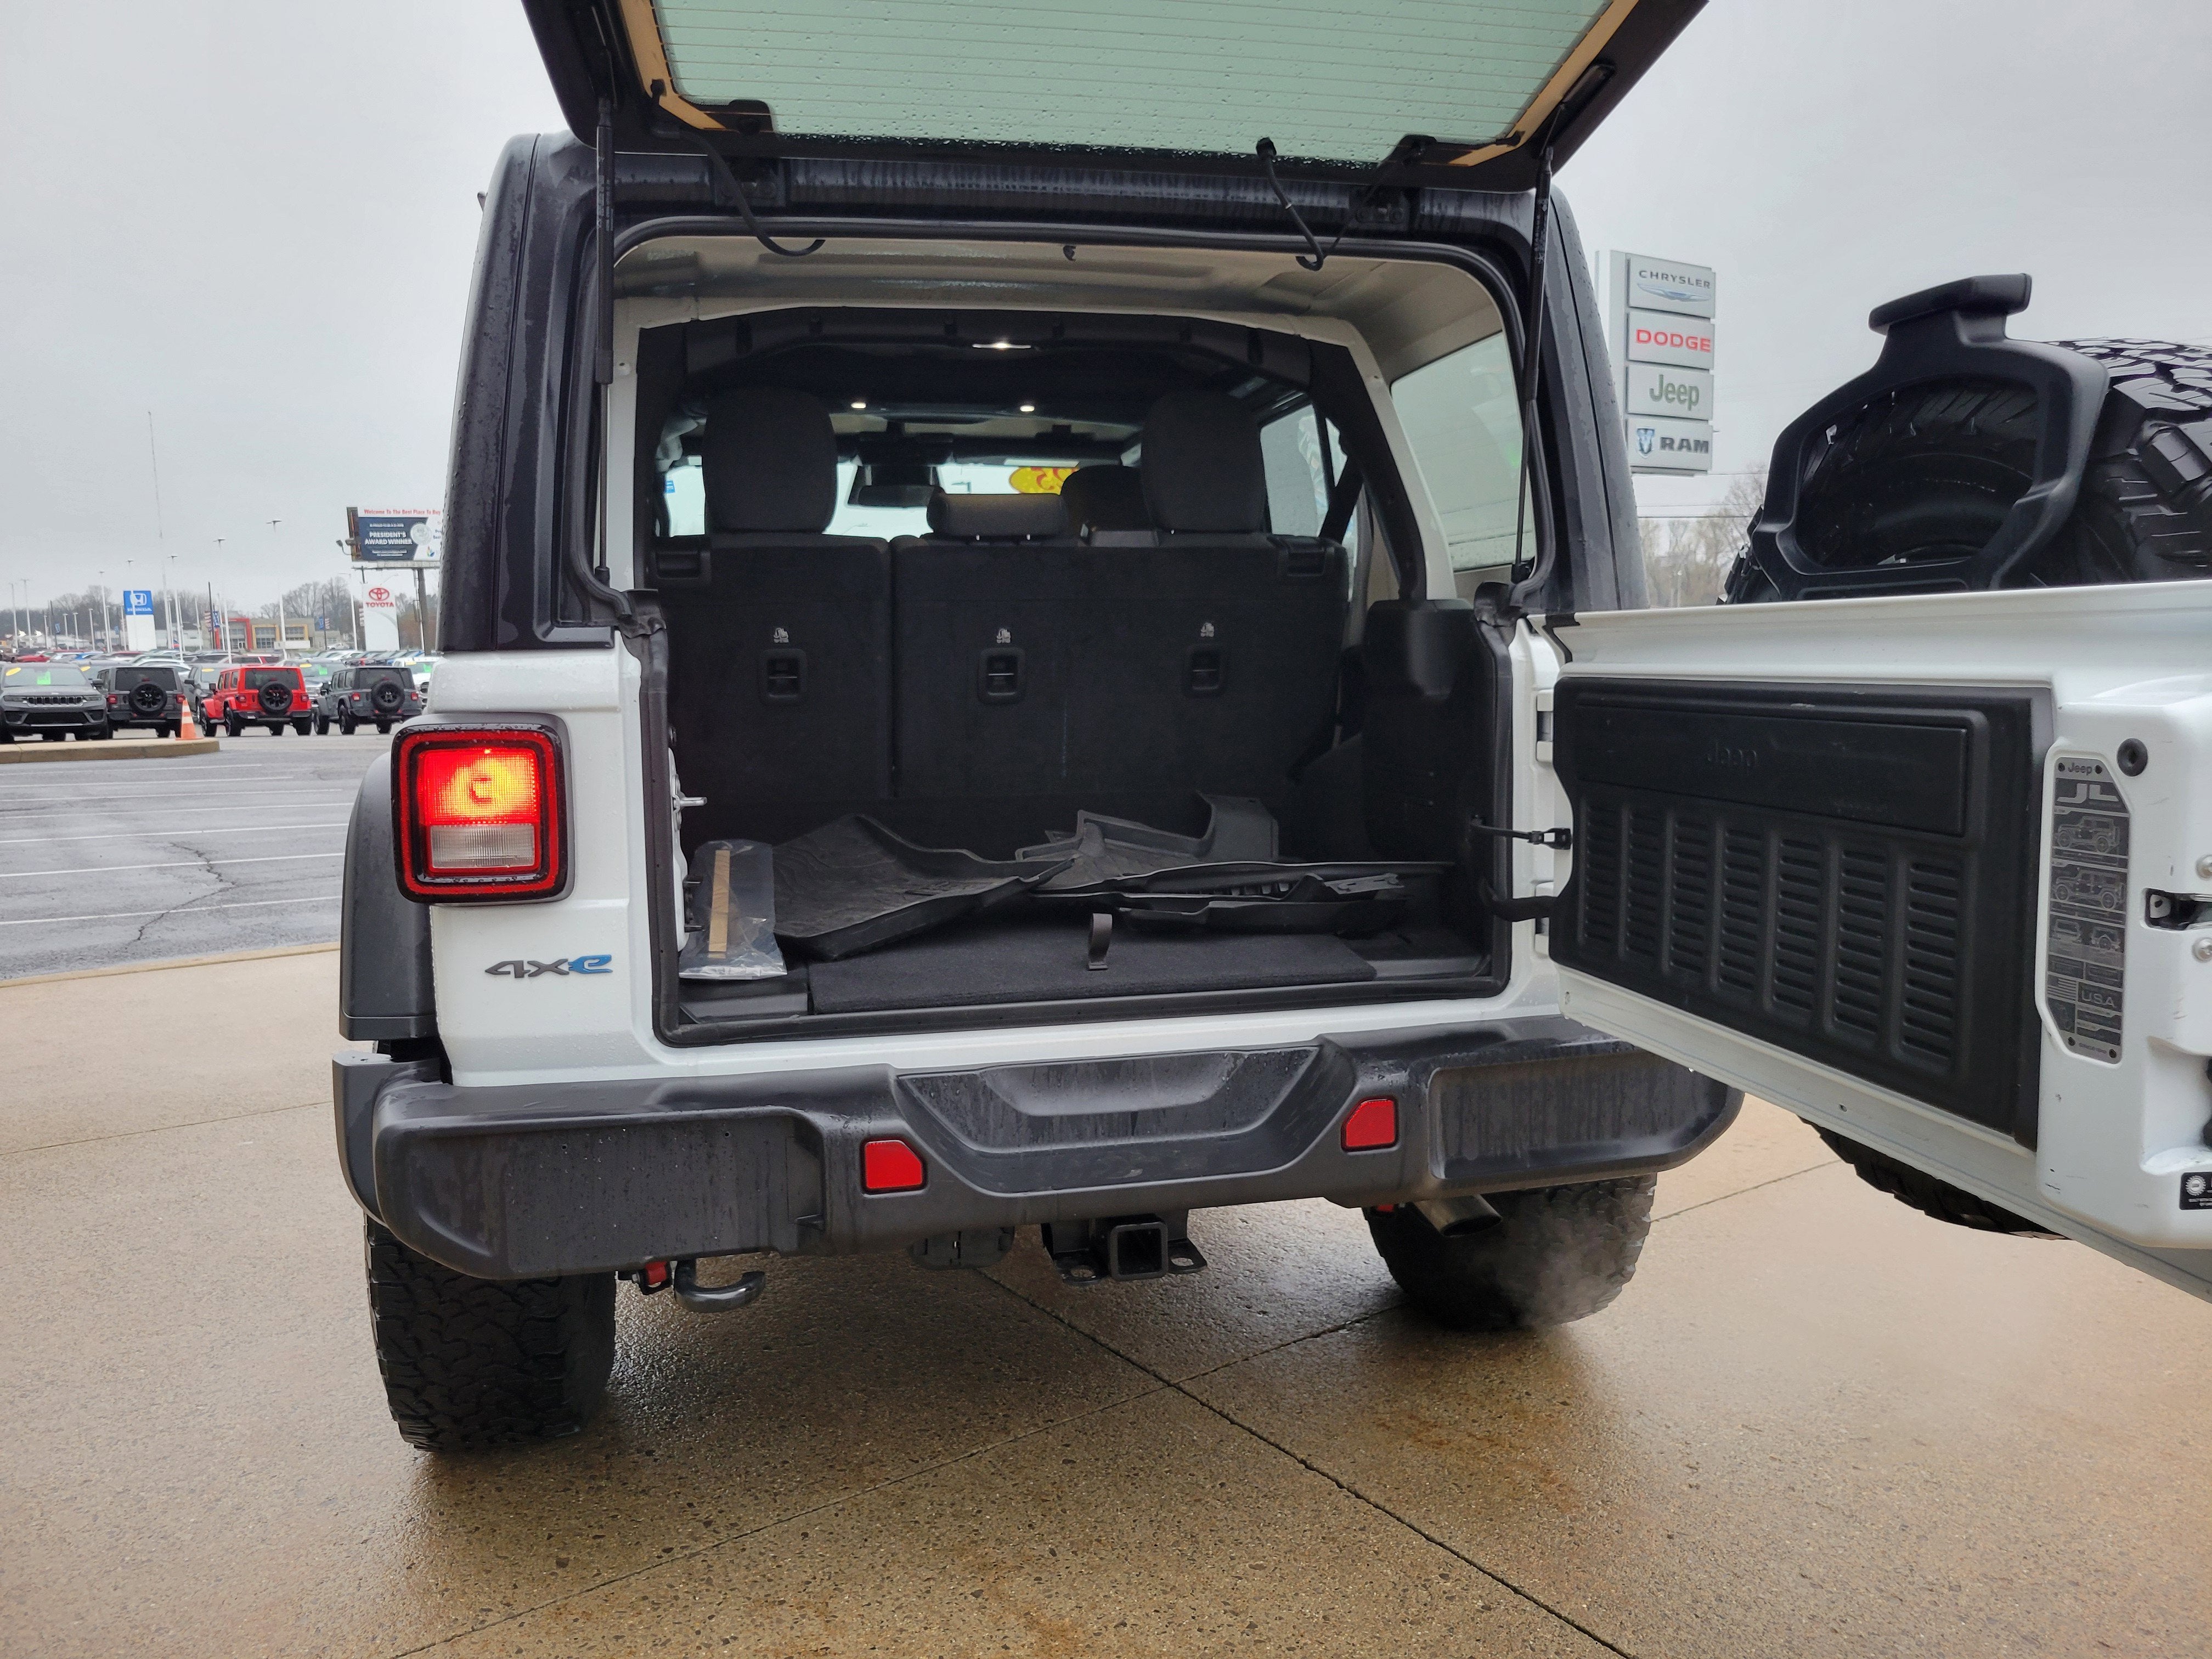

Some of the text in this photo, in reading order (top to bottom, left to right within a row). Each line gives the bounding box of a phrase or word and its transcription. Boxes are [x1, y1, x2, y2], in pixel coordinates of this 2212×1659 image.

[1639, 270, 1711, 289] CHRYSLER
[1636, 329, 1711, 353] DODGE
[1649, 374, 1700, 411] Jeep
[1660, 437, 1709, 454] RAM
[2068, 763, 2093, 776] Jeep
[2057, 783, 2119, 804] JL
[2081, 990, 2115, 1009] USA
